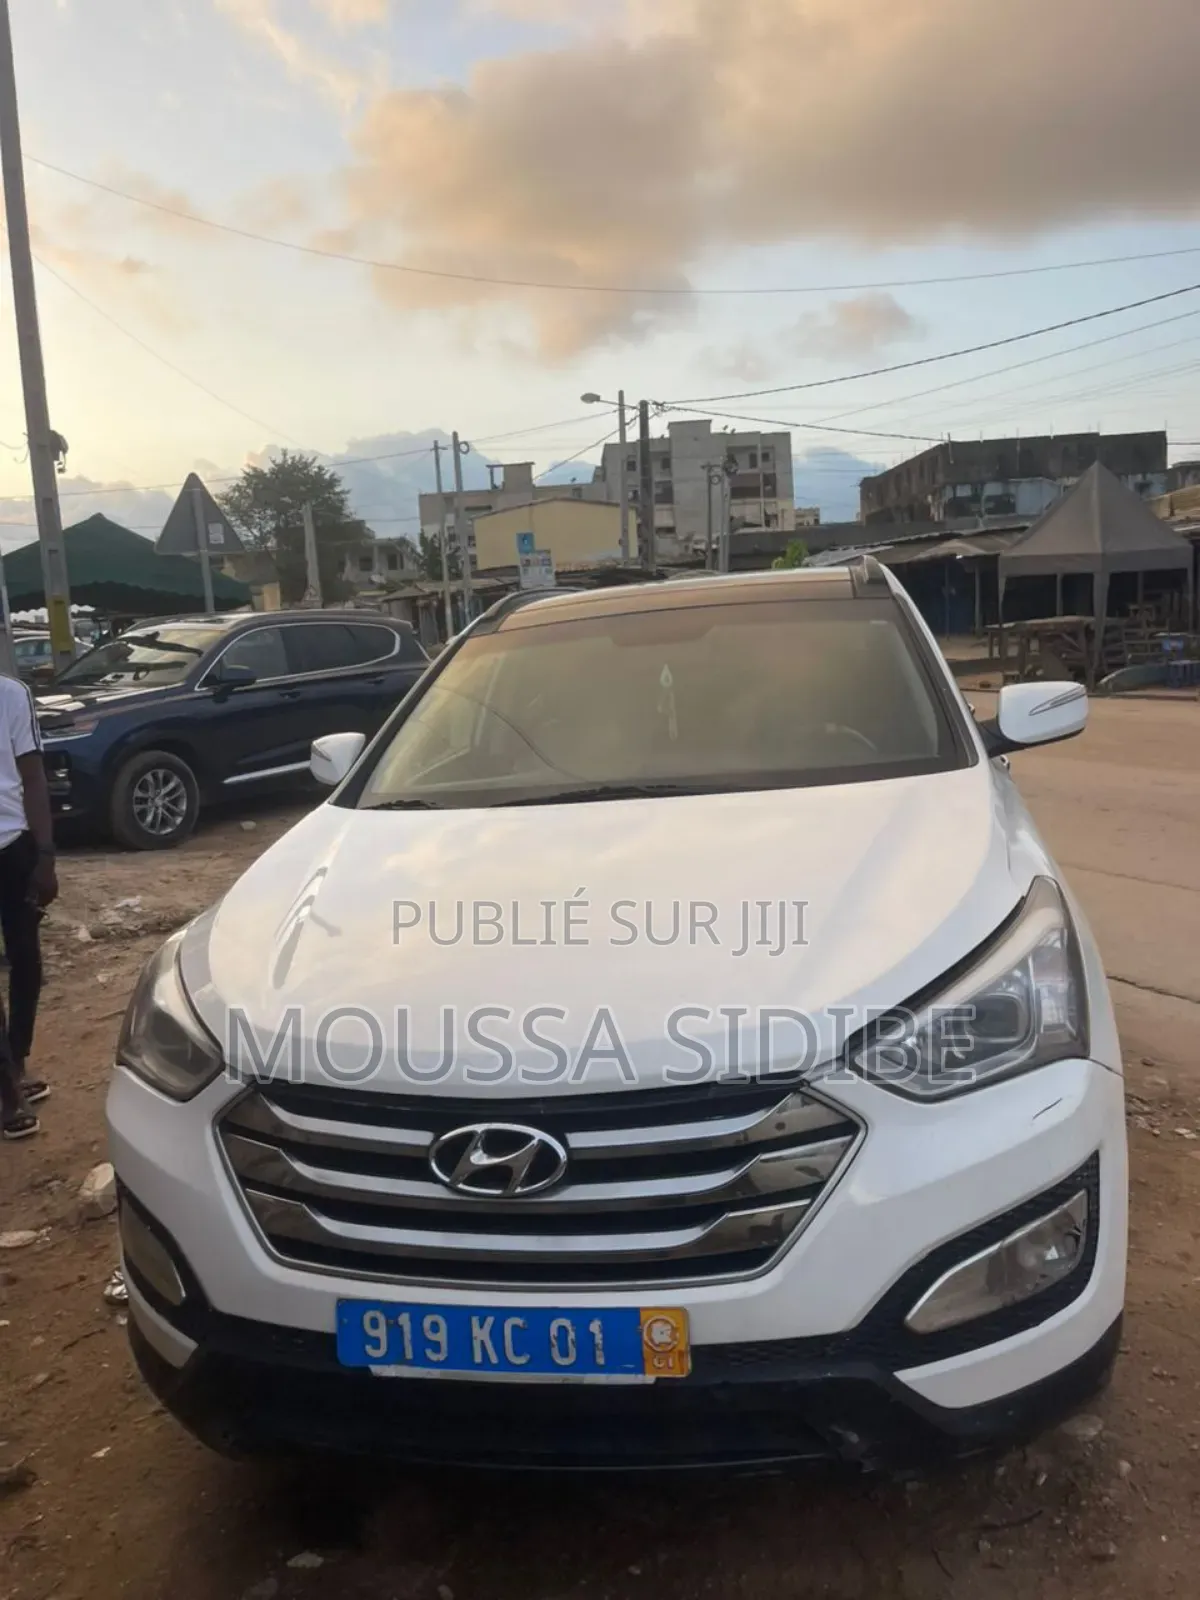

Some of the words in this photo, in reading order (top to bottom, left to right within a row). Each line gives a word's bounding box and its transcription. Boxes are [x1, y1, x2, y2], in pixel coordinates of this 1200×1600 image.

[362, 1309, 449, 1362] 919
[471, 1315, 531, 1365] KC
[549, 1317, 606, 1367] 01
